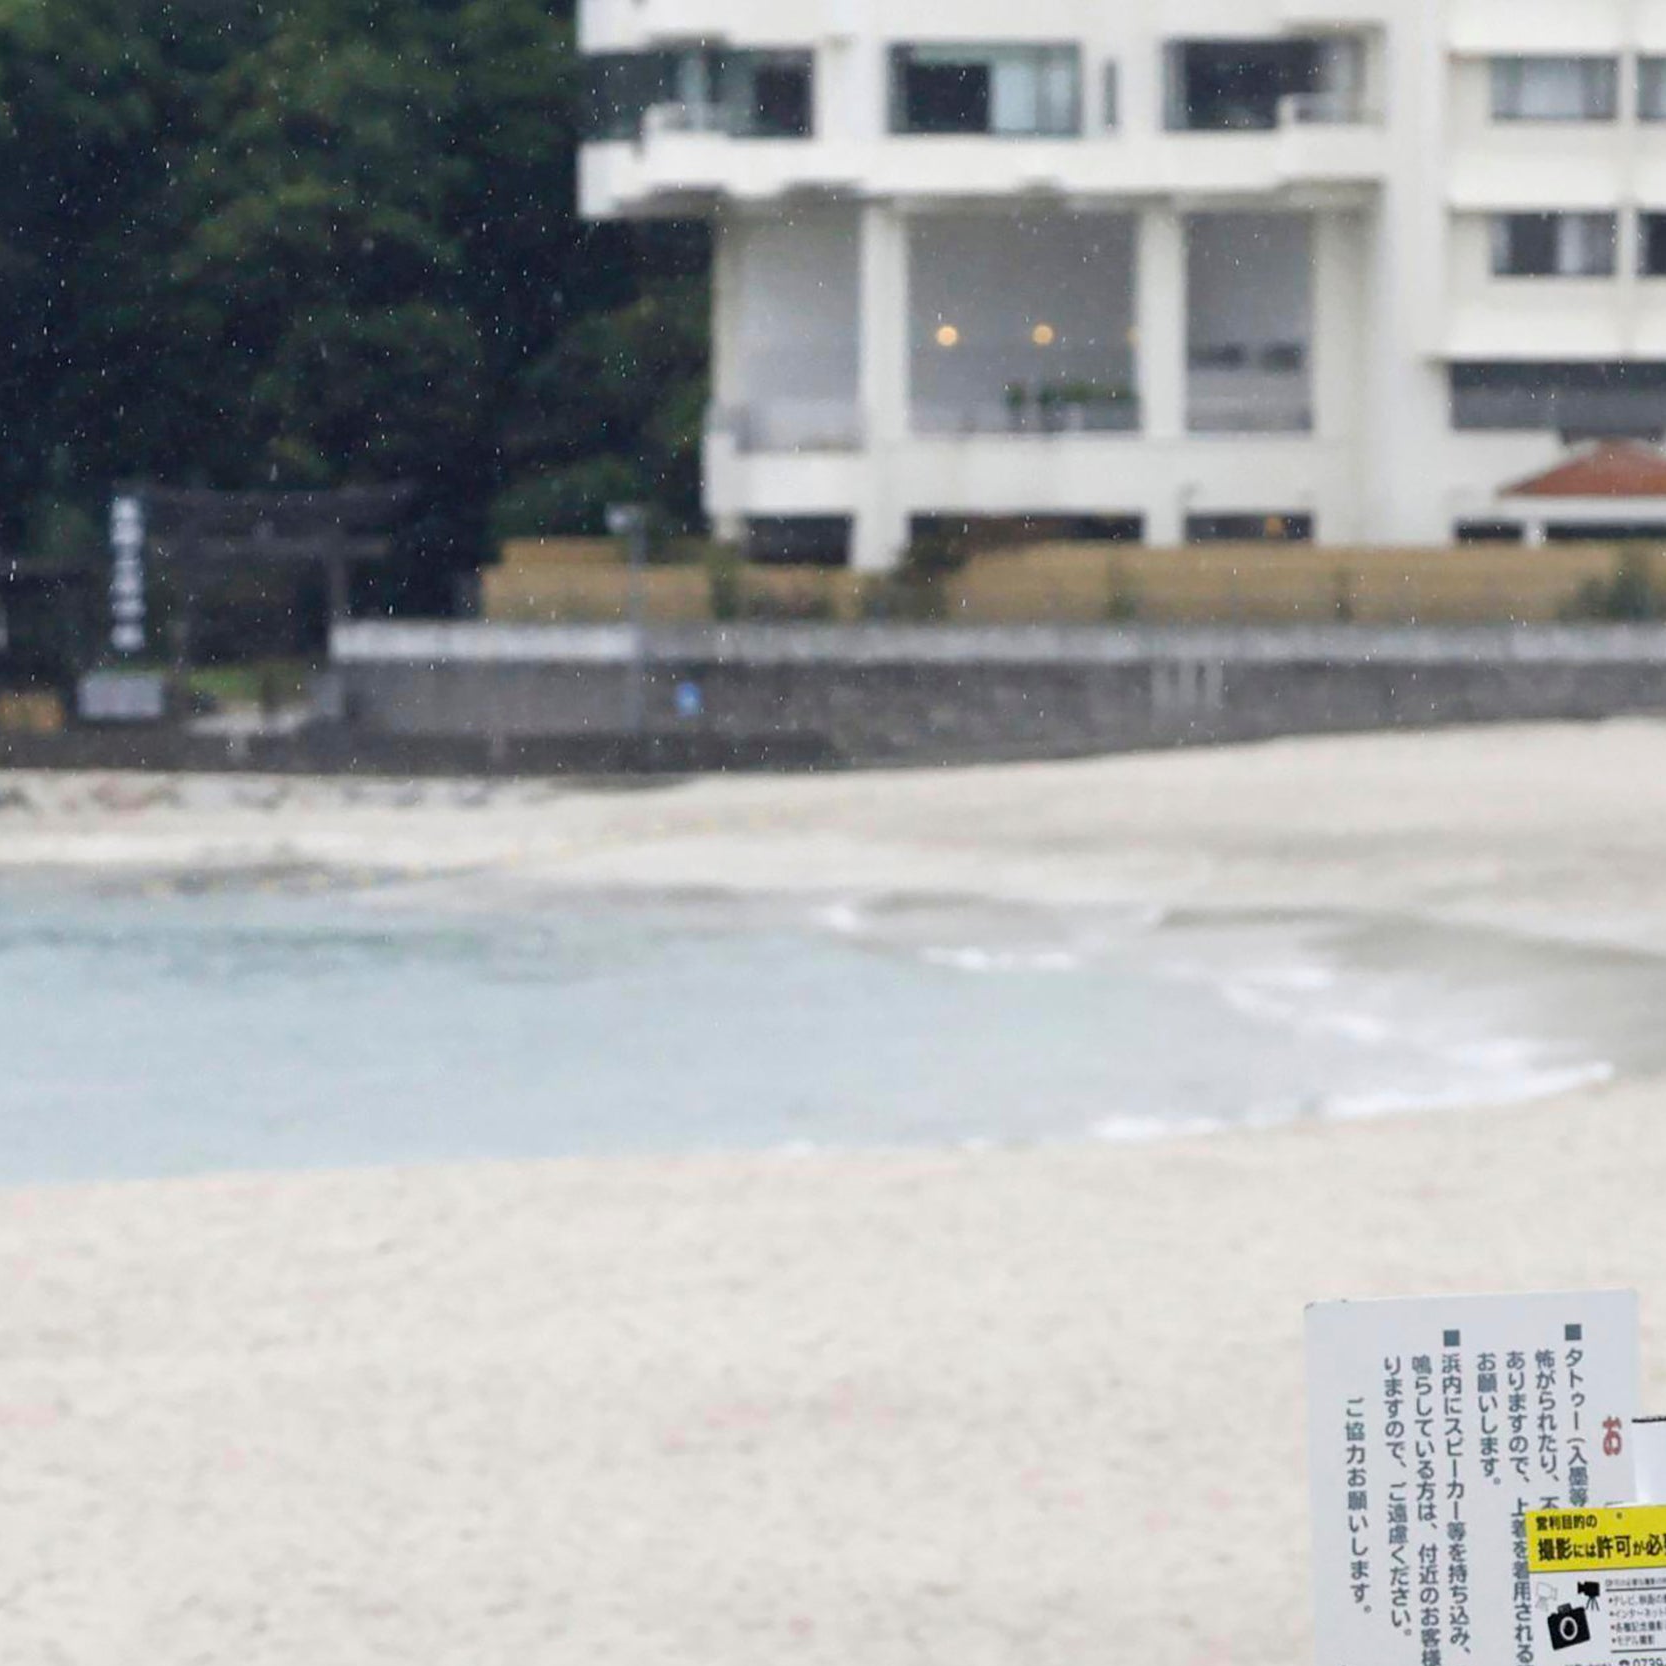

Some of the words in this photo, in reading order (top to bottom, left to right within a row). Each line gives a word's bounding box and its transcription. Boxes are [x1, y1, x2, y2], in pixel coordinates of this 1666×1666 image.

[1345, 1397, 1371, 1613] ご協力お願いします。
[1477, 1352, 1501, 1485] お願いします。
